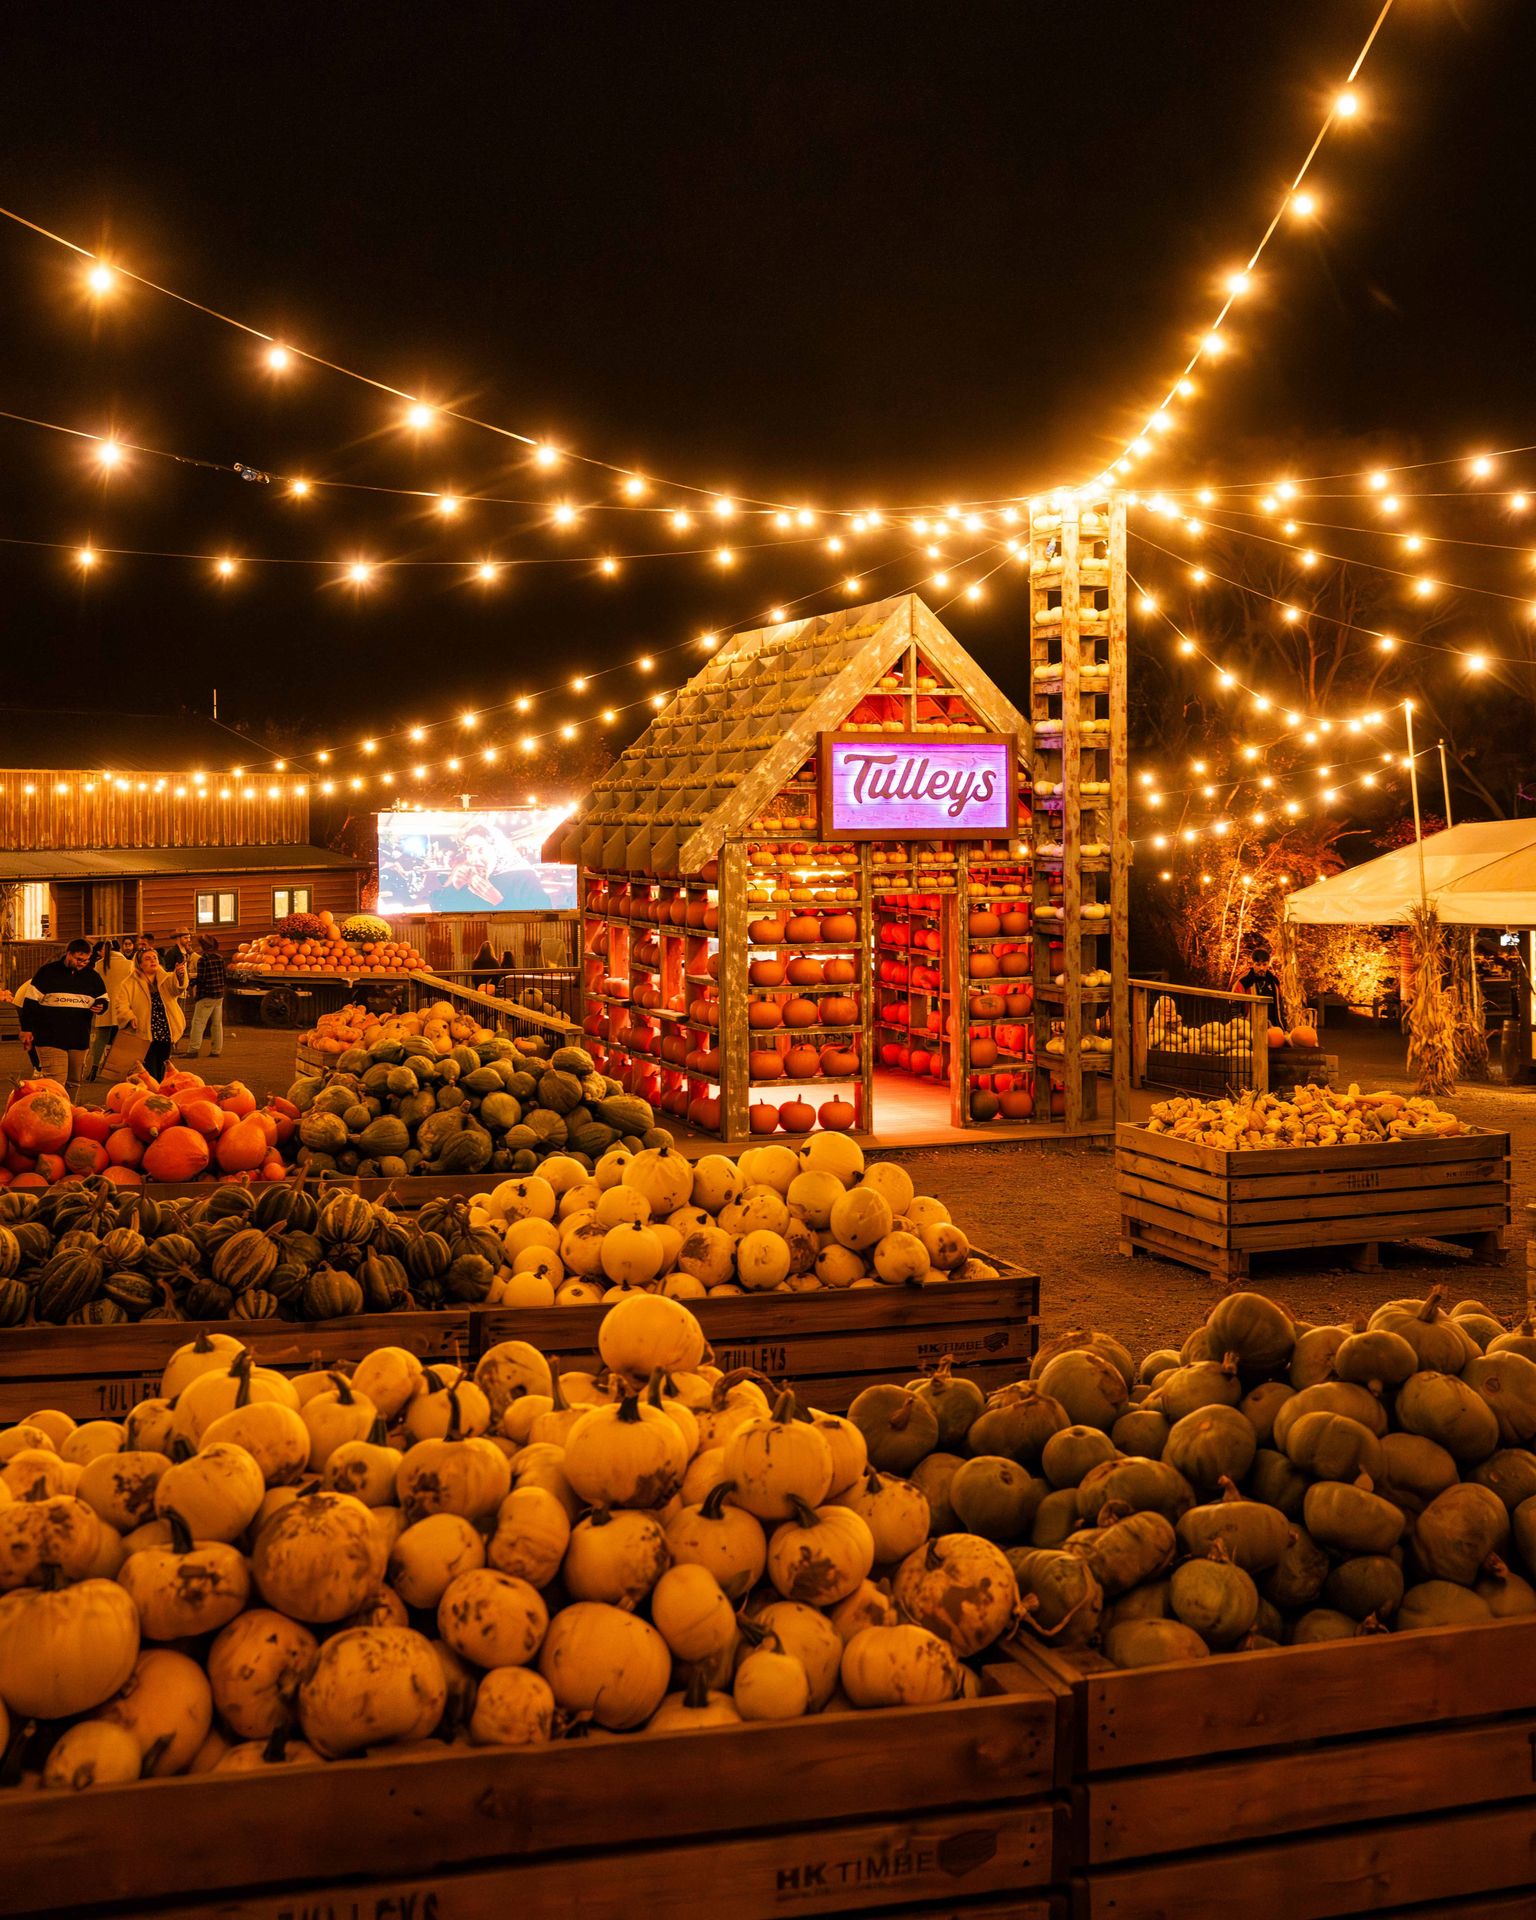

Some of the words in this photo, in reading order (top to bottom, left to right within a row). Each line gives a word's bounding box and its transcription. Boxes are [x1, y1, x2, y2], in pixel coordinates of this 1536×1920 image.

[844, 754, 996, 817] Tulleys
[723, 1348, 786, 1371] TULLEYS
[918, 1344, 940, 1354] HK
[97, 1384, 161, 1411] TULLEY
[776, 1862, 827, 1890] HK
